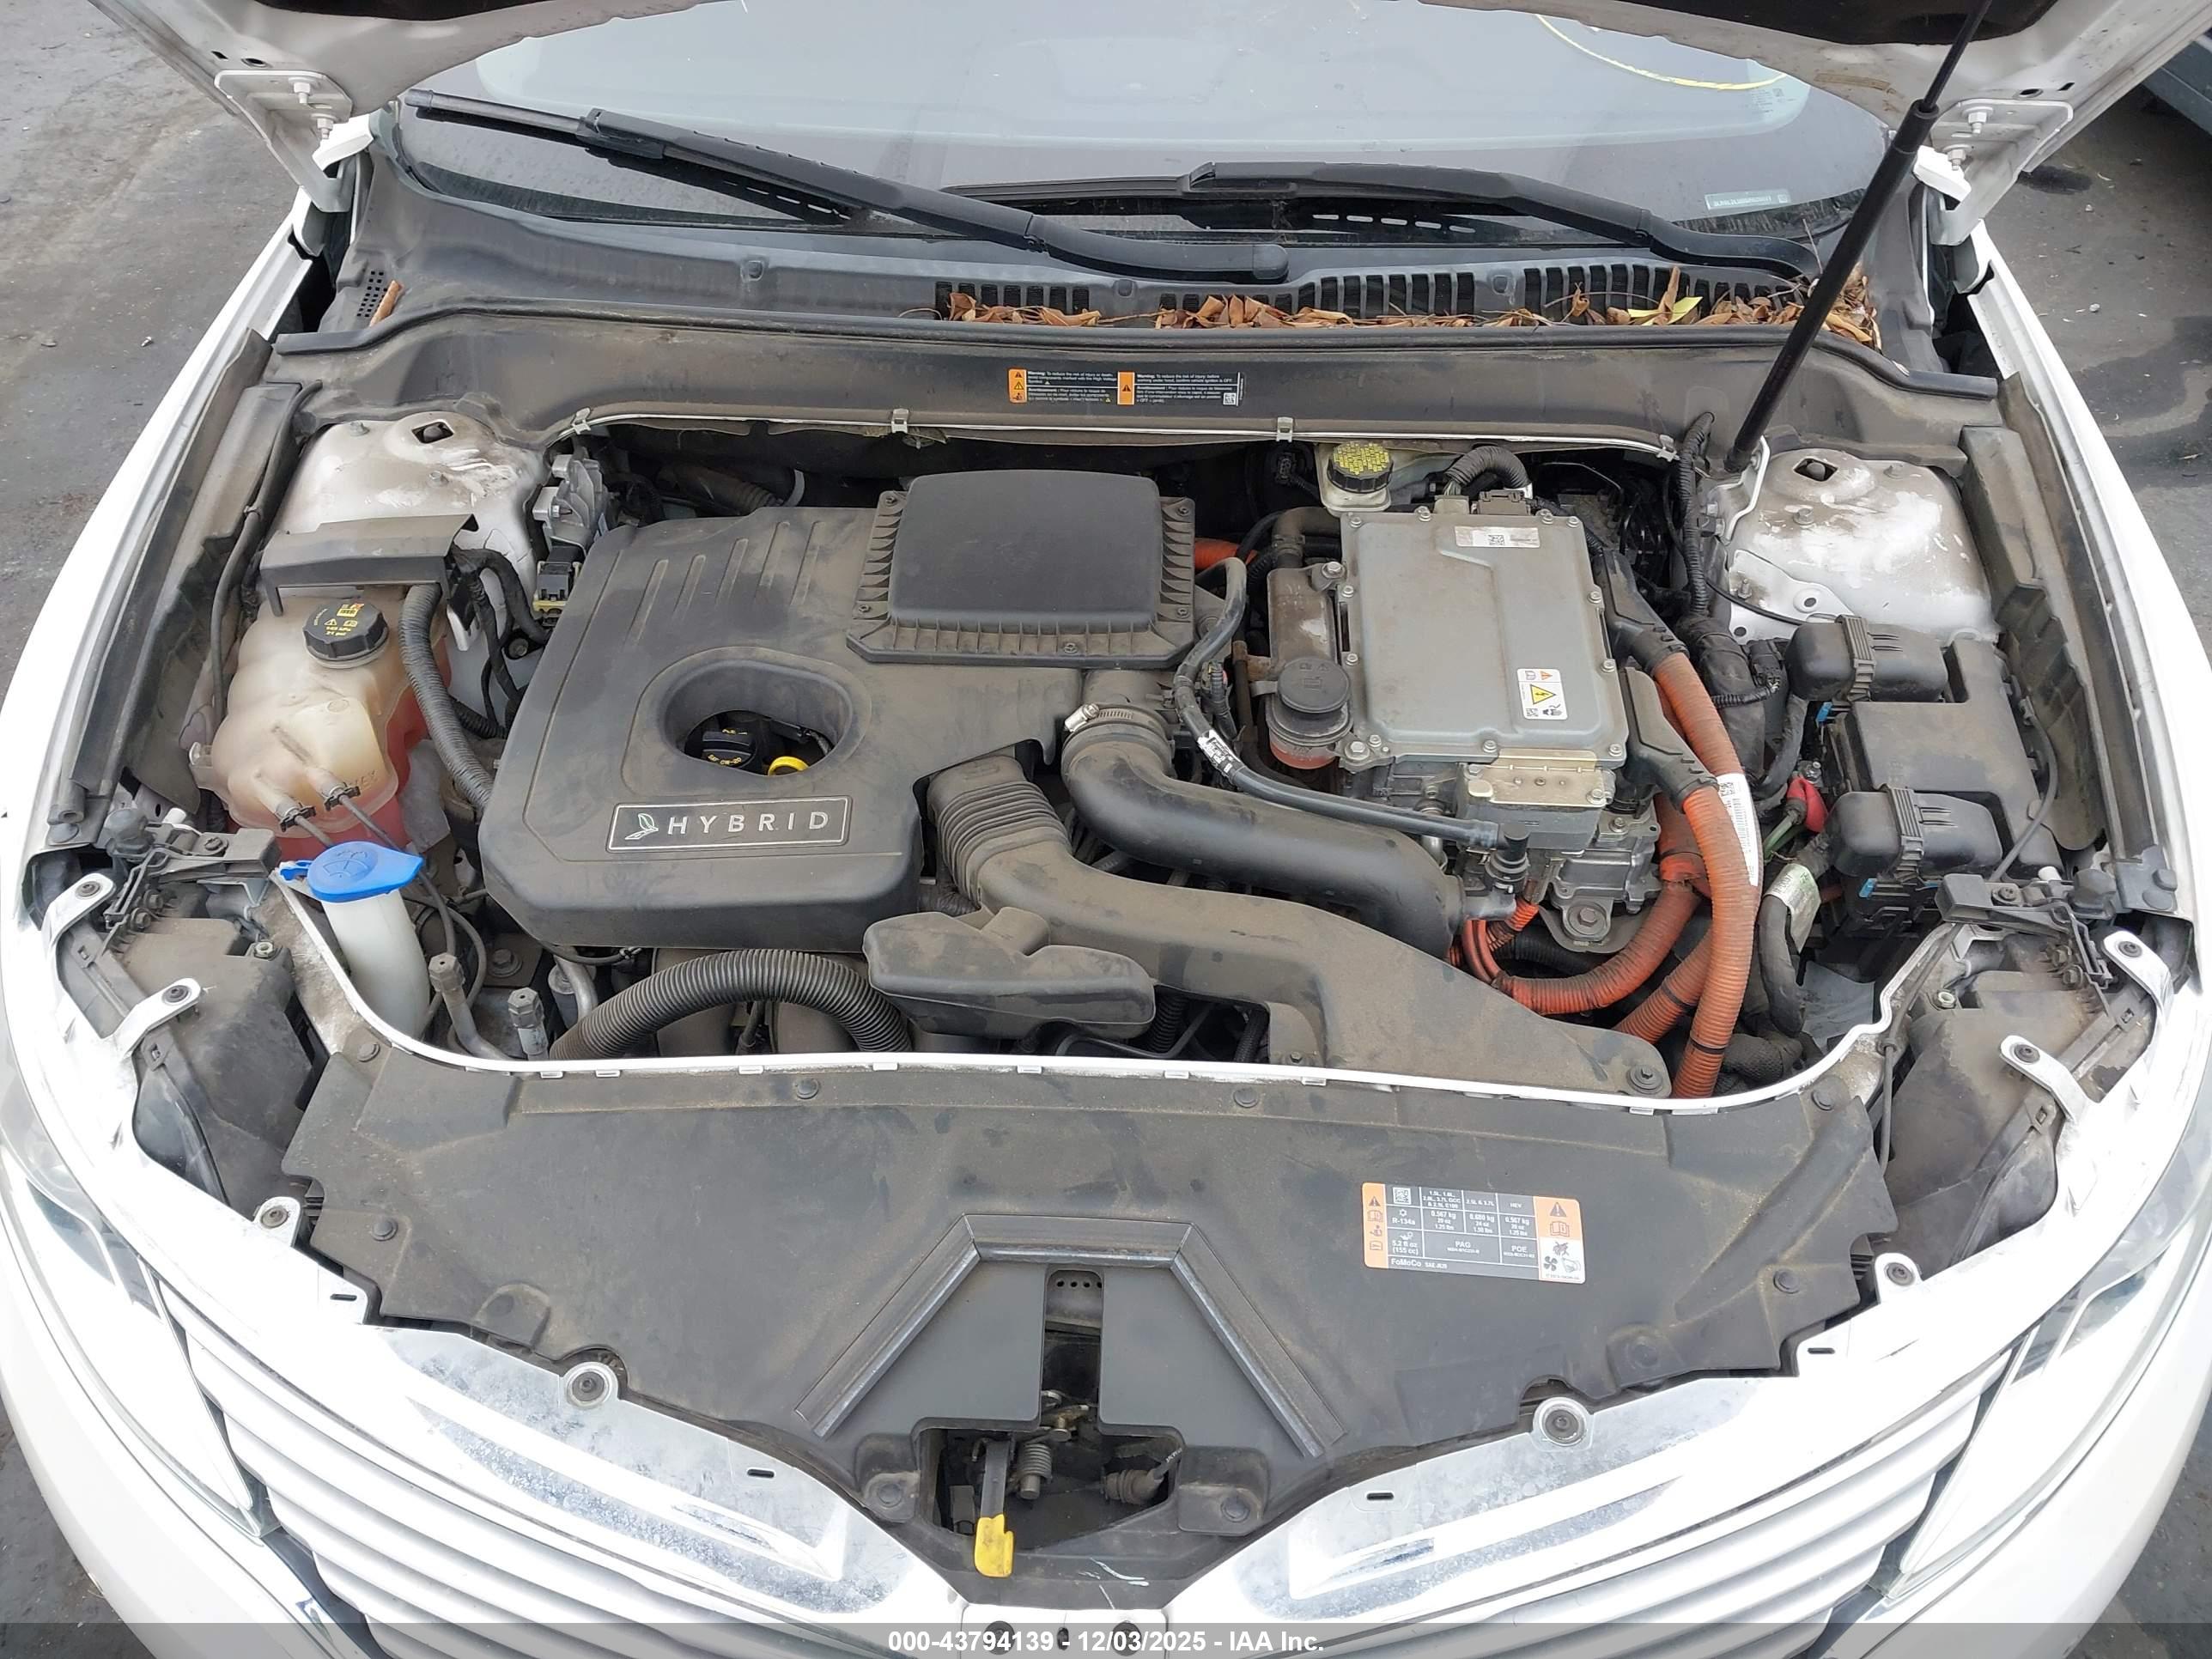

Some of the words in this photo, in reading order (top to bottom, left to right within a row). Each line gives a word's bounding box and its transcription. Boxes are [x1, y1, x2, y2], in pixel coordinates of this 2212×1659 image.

[667, 811, 829, 835] HYBRID
[1392, 1217, 1415, 1225] R-134a
[1391, 1258, 1421, 1267] FoMoCo
